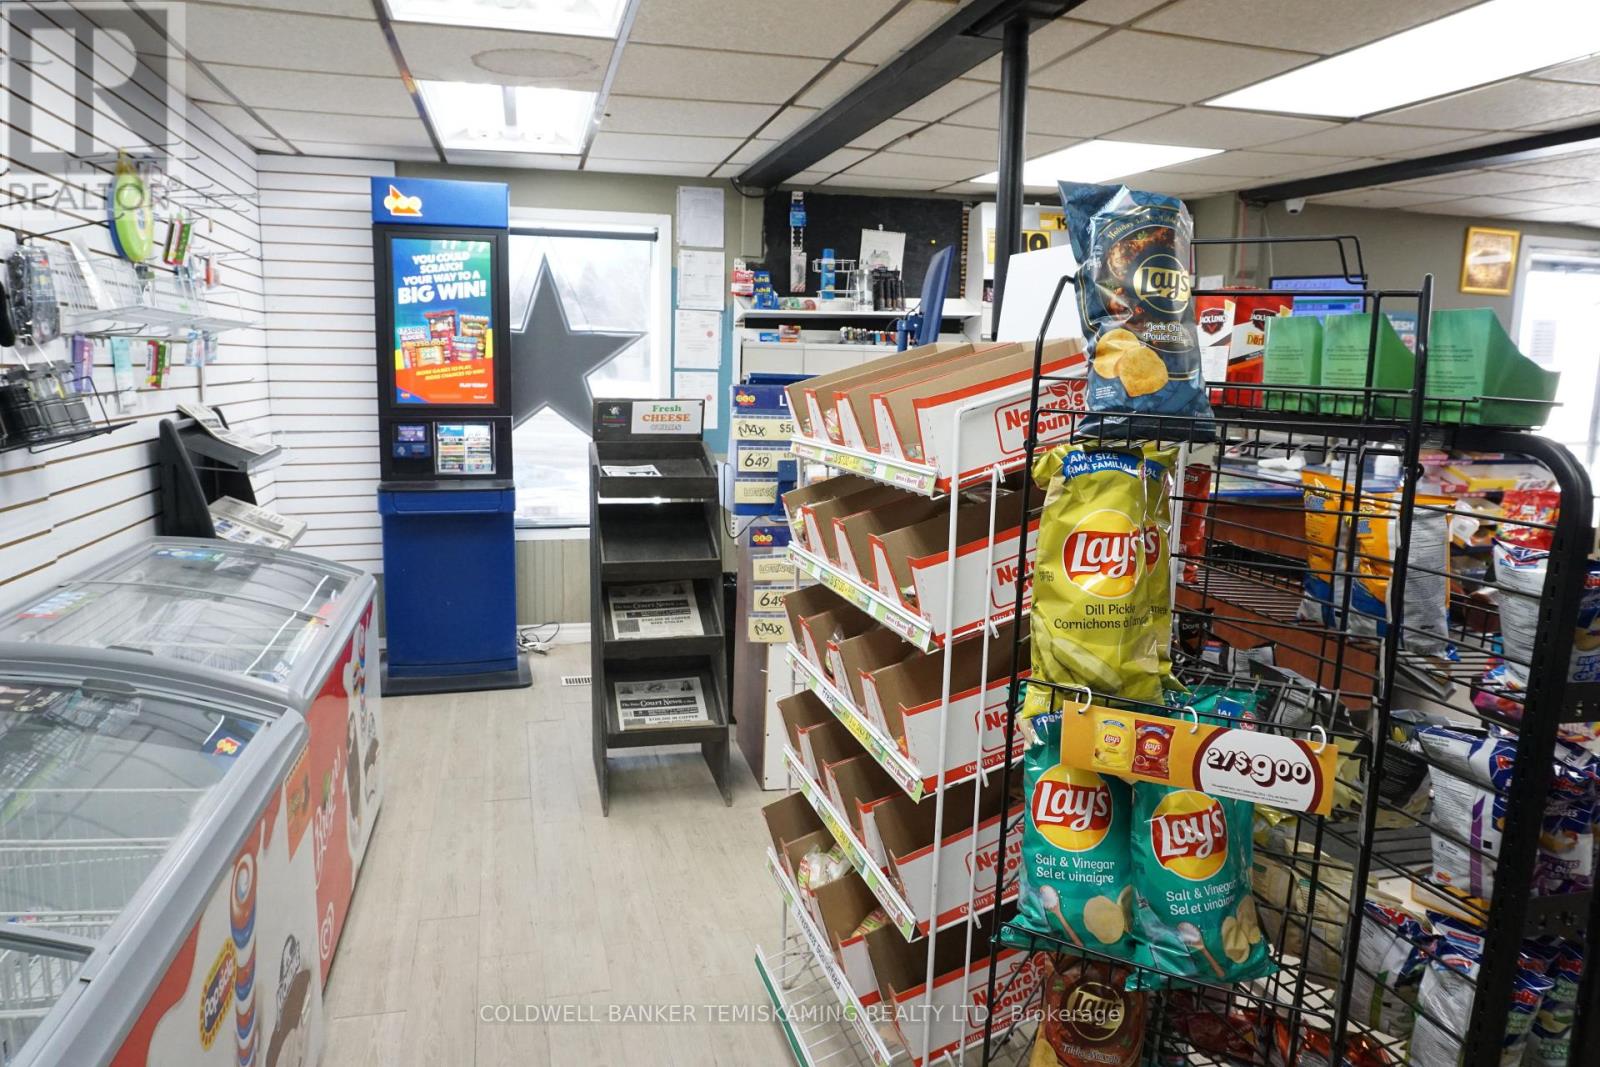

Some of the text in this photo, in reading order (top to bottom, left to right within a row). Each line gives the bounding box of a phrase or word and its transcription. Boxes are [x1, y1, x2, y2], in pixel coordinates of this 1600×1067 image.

[412, 254, 435, 265] YOU
[420, 262, 464, 274] SCRATCH
[402, 275, 433, 286] YOUR
[472, 270, 481, 279] A
[397, 280, 487, 305] BIG WIN!
[641, 413, 692, 423] CHEESE
[739, 423, 765, 437] MAX
[744, 453, 770, 468] 649
[1095, 453, 1120, 461] SIZE
[1085, 604, 1105, 615] Dill
[754, 622, 784, 636] MAX
[1053, 618, 1121, 630] Cornichons
[1036, 782, 1108, 831] Lay's
[1160, 805, 1224, 858] Lay's
[1036, 853, 1115, 873] Salt & Vinegar
[1037, 866, 1115, 885] Sel et vinaigre
[1166, 889, 1191, 902] Salt
[1194, 888, 1202, 899] &
[1170, 903, 1189, 916] Sel
[1190, 904, 1202, 914] et
